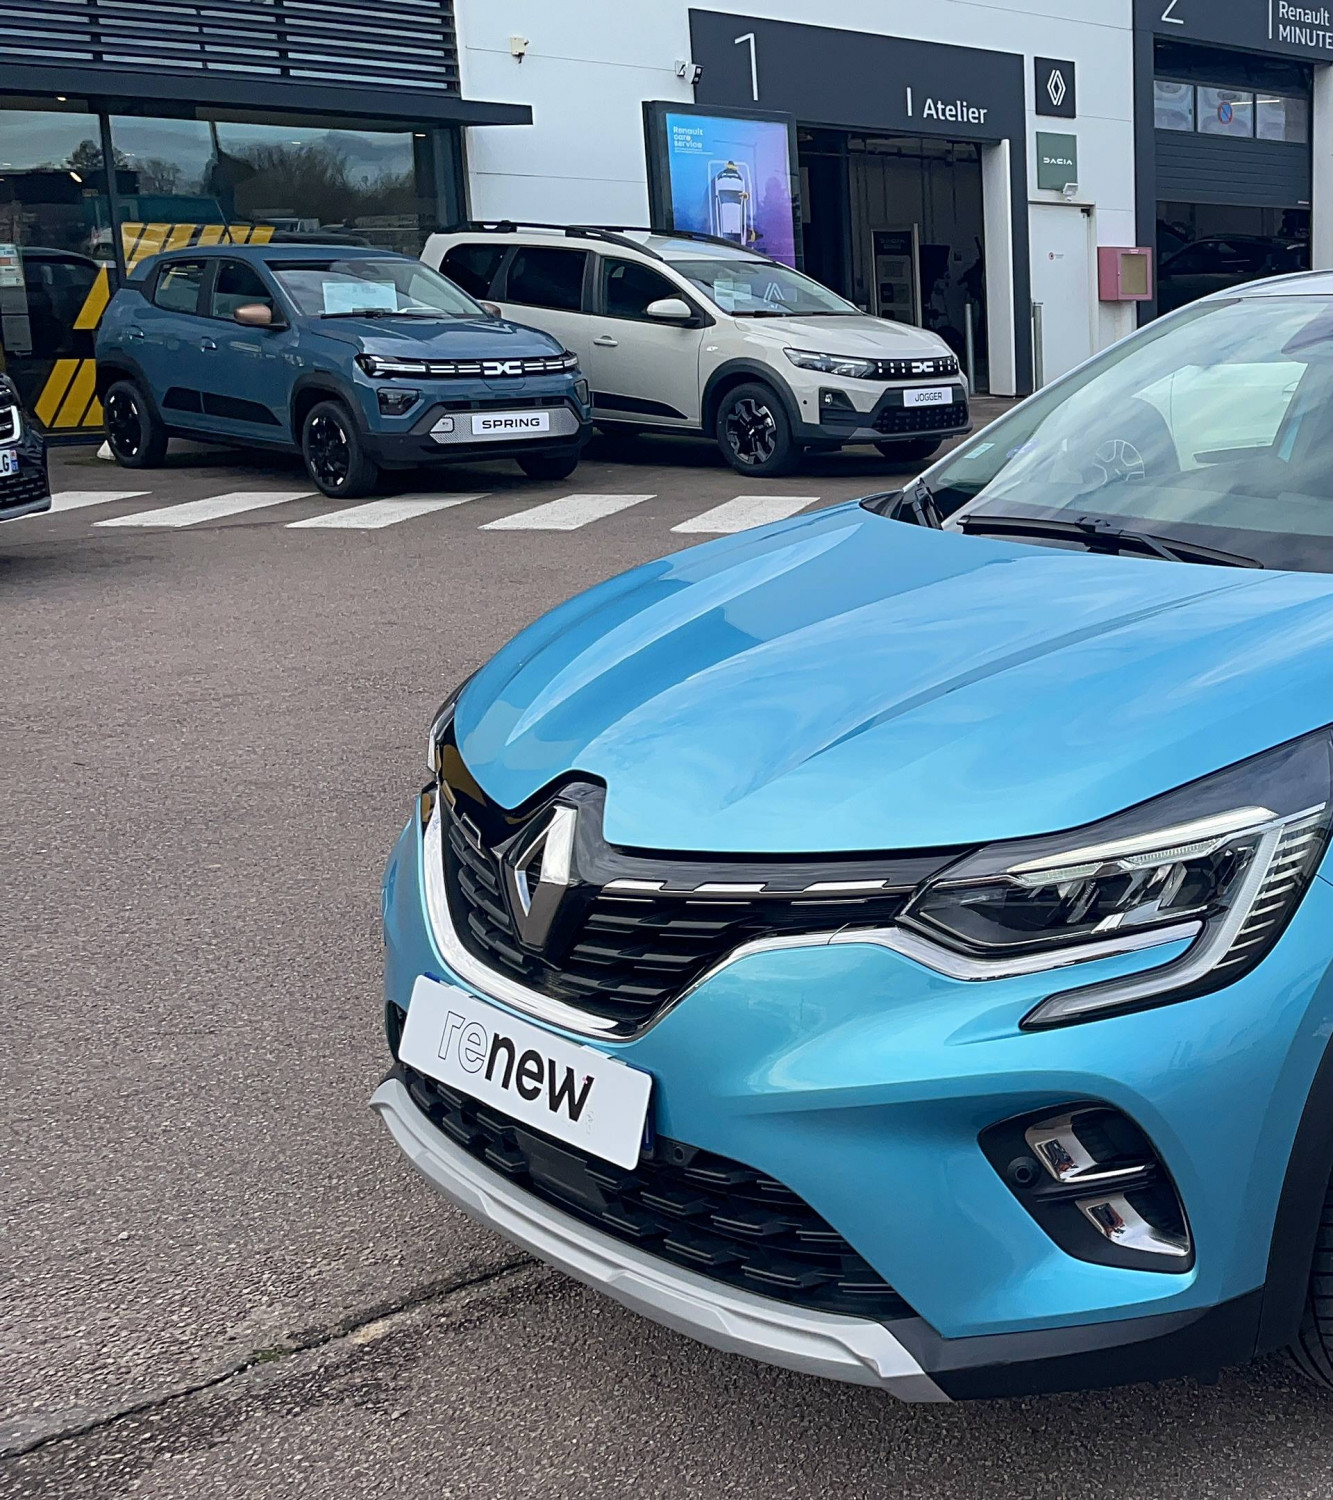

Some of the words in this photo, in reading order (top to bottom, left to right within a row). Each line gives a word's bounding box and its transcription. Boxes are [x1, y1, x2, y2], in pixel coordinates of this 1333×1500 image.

[1278, 1, 1330, 26] Renault
[1278, 24, 1333, 49] MINUTE
[734, 32, 759, 101] 1
[922, 98, 988, 124] Atelier
[673, 126, 703, 135] Renault
[1043, 157, 1073, 166] DACIA
[914, 391, 943, 402] JOGGER
[481, 417, 540, 430] SPRING
[437, 1010, 595, 1123] renew
